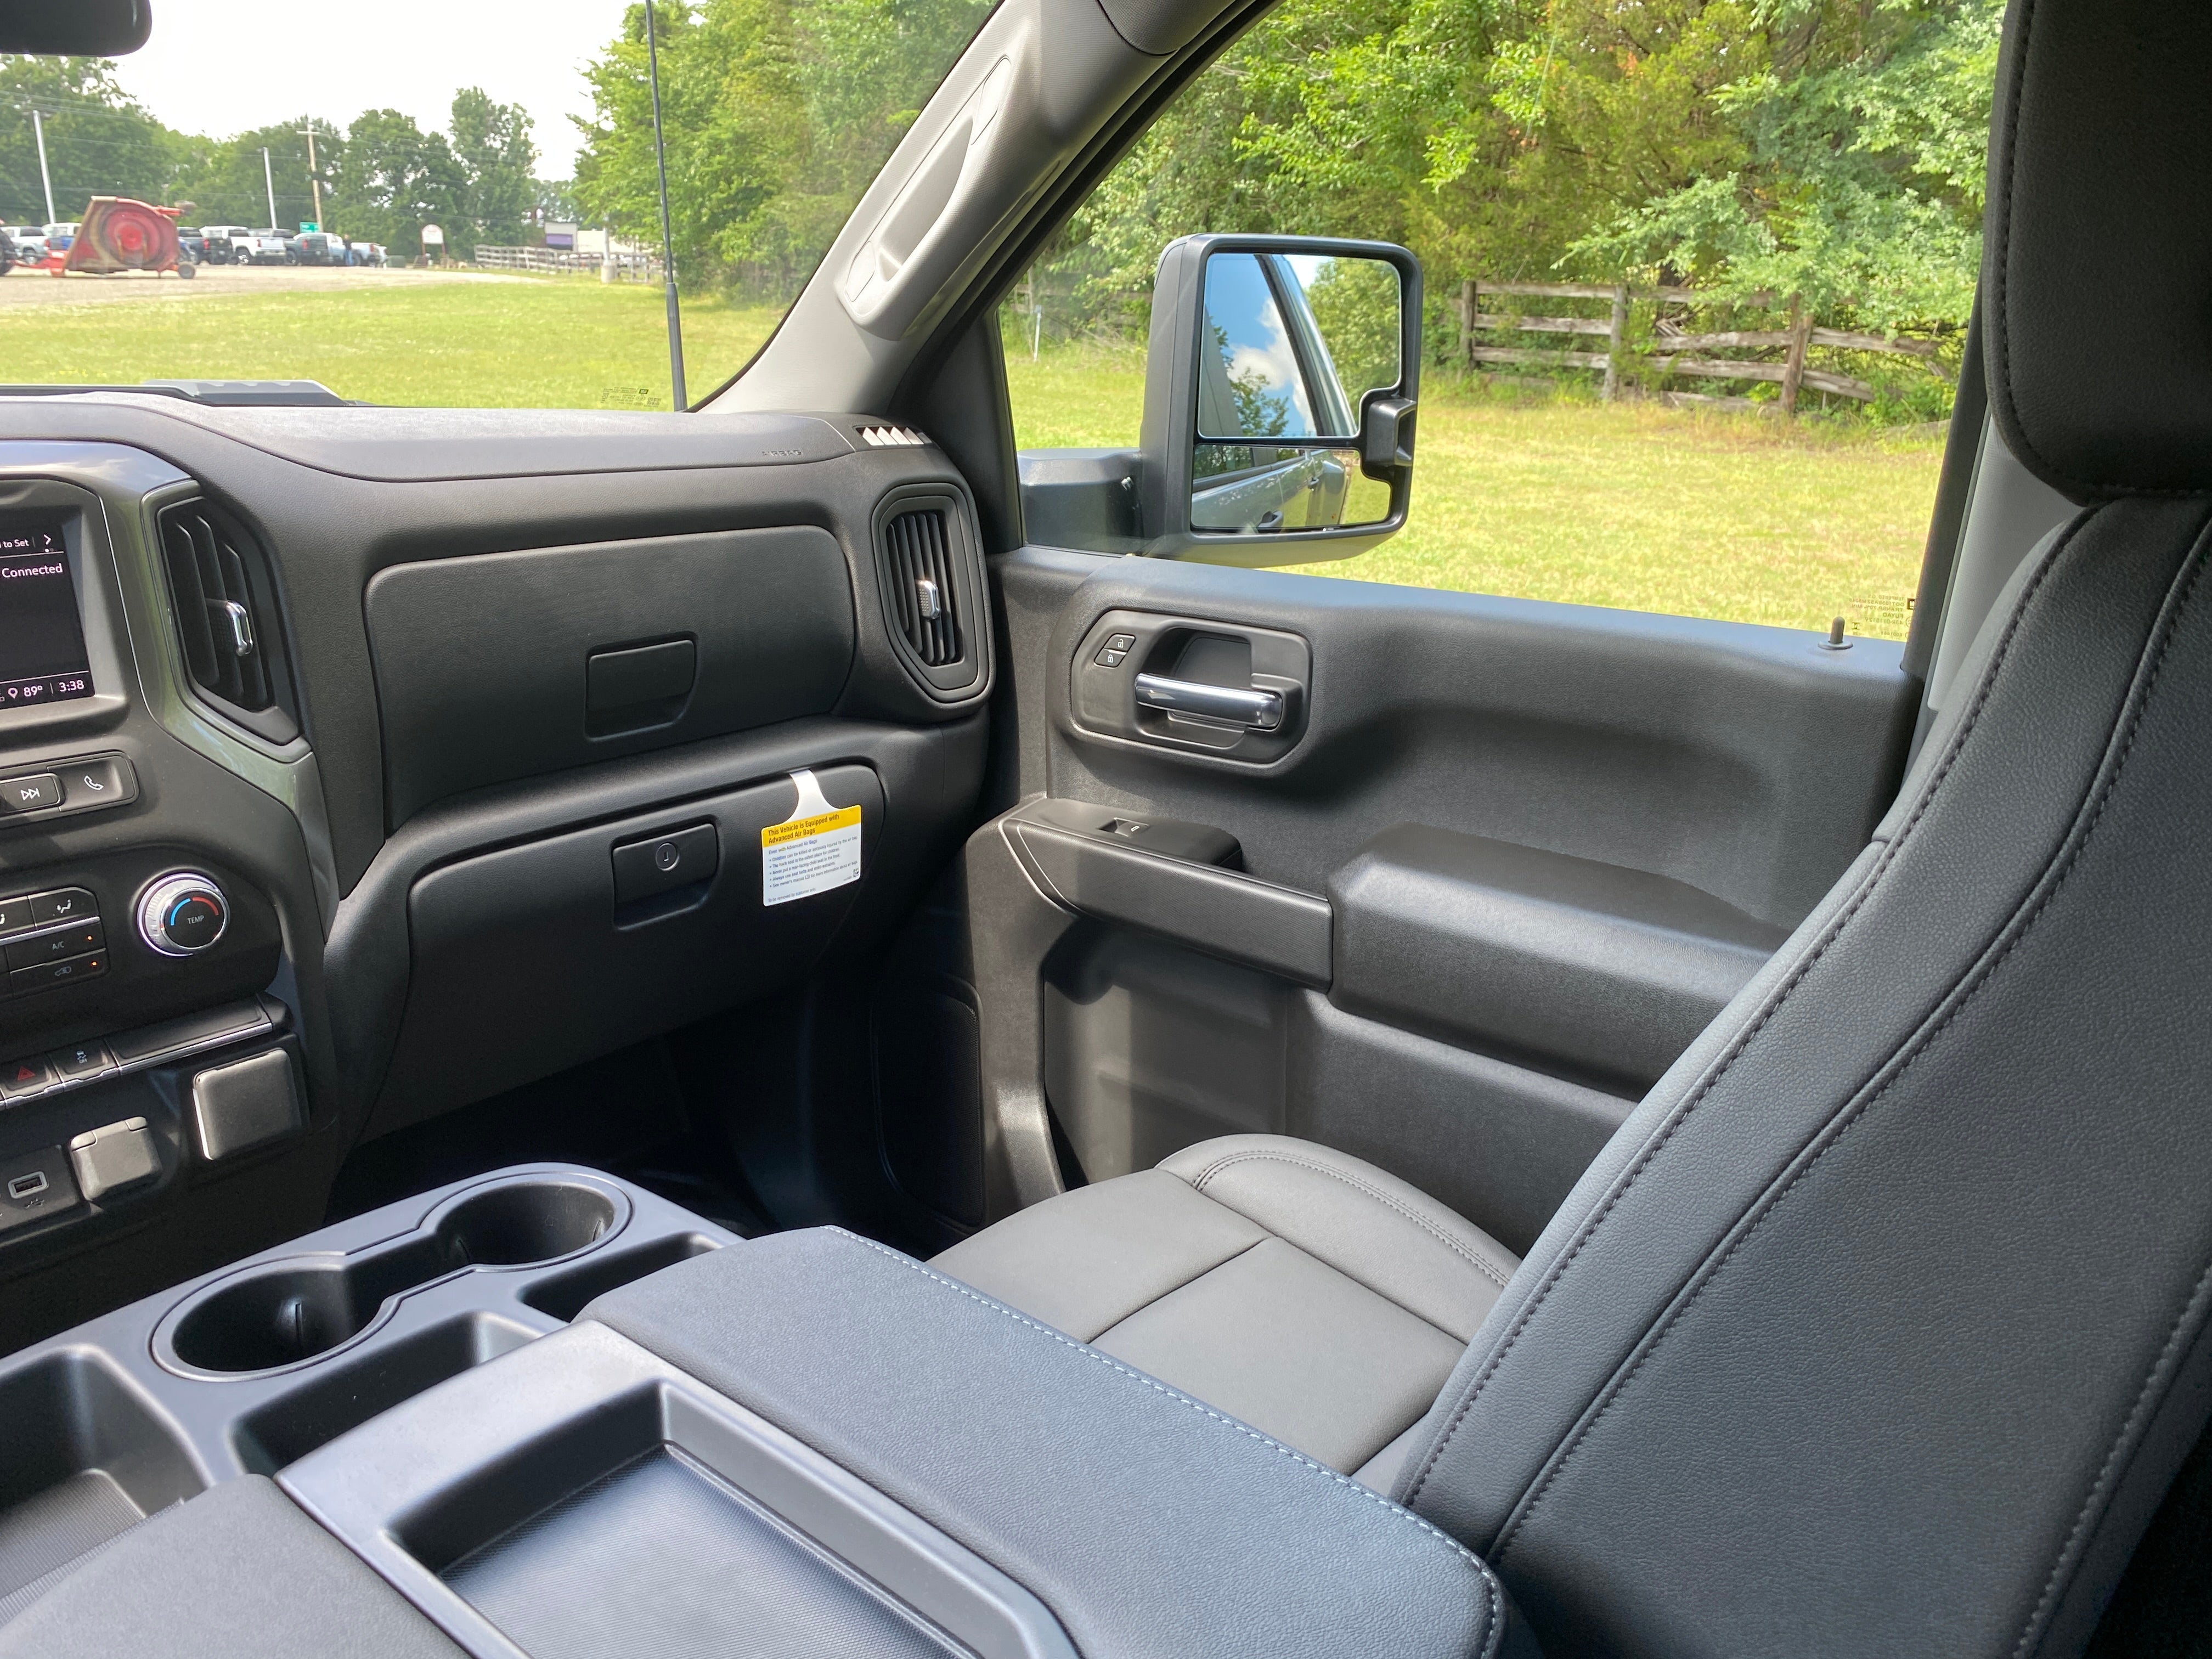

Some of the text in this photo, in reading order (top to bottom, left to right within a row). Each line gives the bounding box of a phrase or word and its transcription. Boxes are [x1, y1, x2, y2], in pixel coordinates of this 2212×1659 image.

[14, 539, 30, 548] Set
[2, 563, 63, 578] Connected
[59, 680, 84, 692] 3:38
[780, 824, 799, 833] Vehicle
[805, 816, 828, 827] Equipped
[769, 833, 794, 844] Advanced
[187, 915, 205, 925] TEMP
[52, 941, 65, 950] A/C
